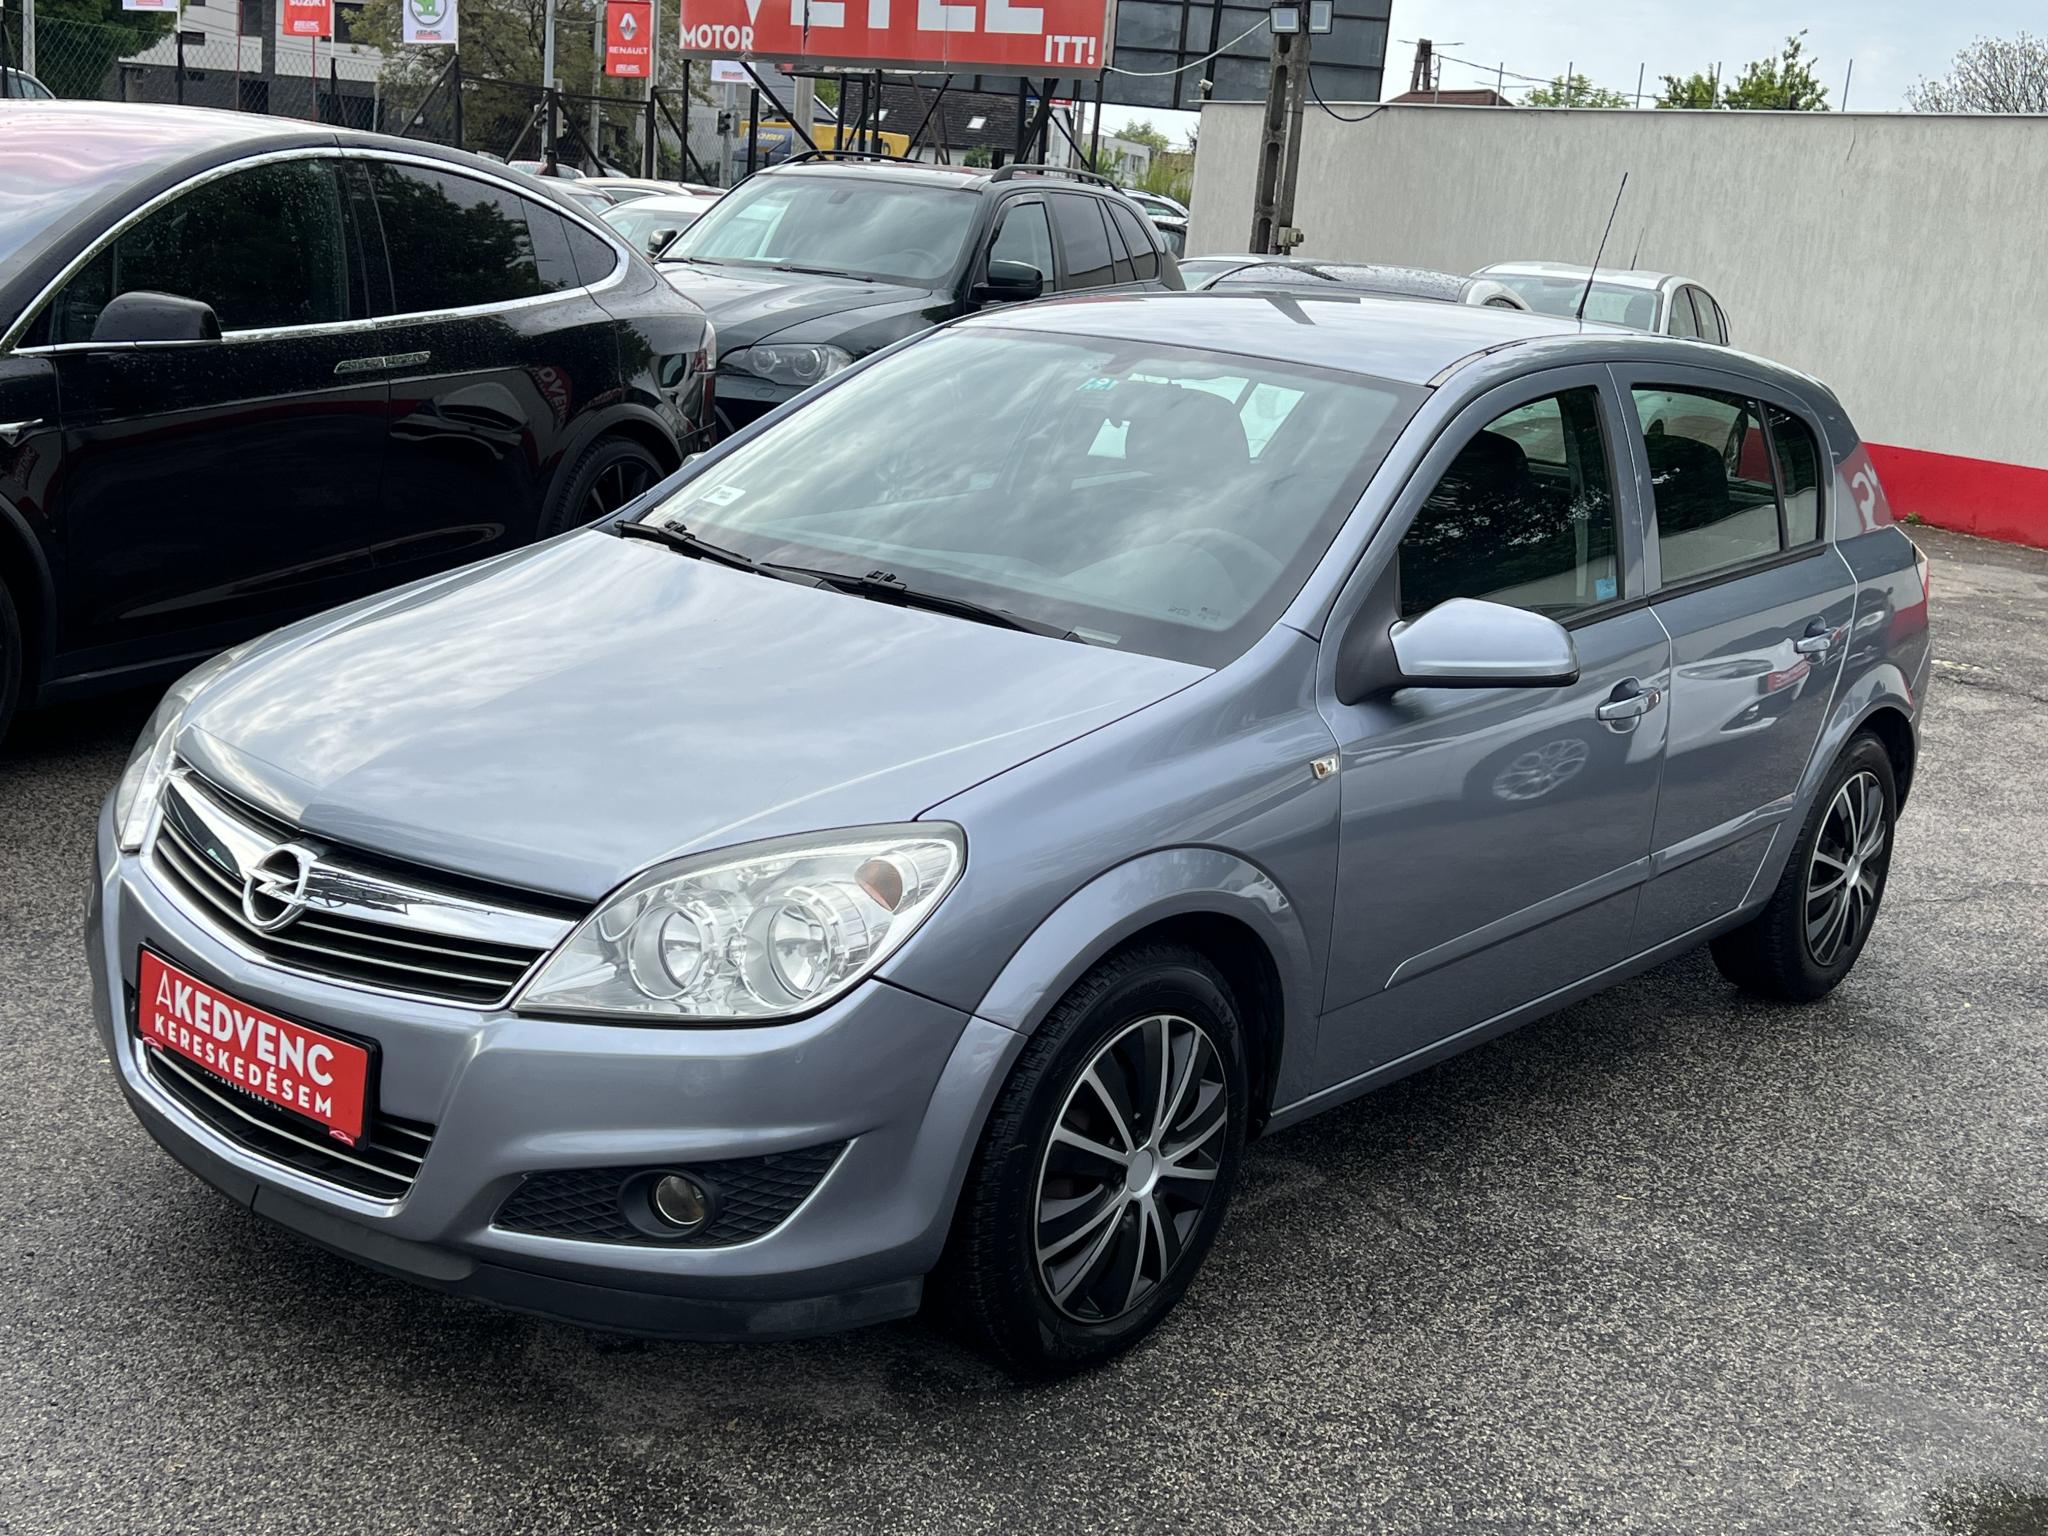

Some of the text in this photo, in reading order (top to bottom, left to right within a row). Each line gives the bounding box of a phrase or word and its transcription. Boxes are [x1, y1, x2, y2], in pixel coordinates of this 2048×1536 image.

[609, 46, 648, 55] RENAULT
[680, 24, 754, 50] MOTOR
[1045, 35, 1096, 65] ITT!
[155, 970, 334, 1086] AKEDVENC
[154, 1012, 333, 1118] KERESKEDÉSEM
